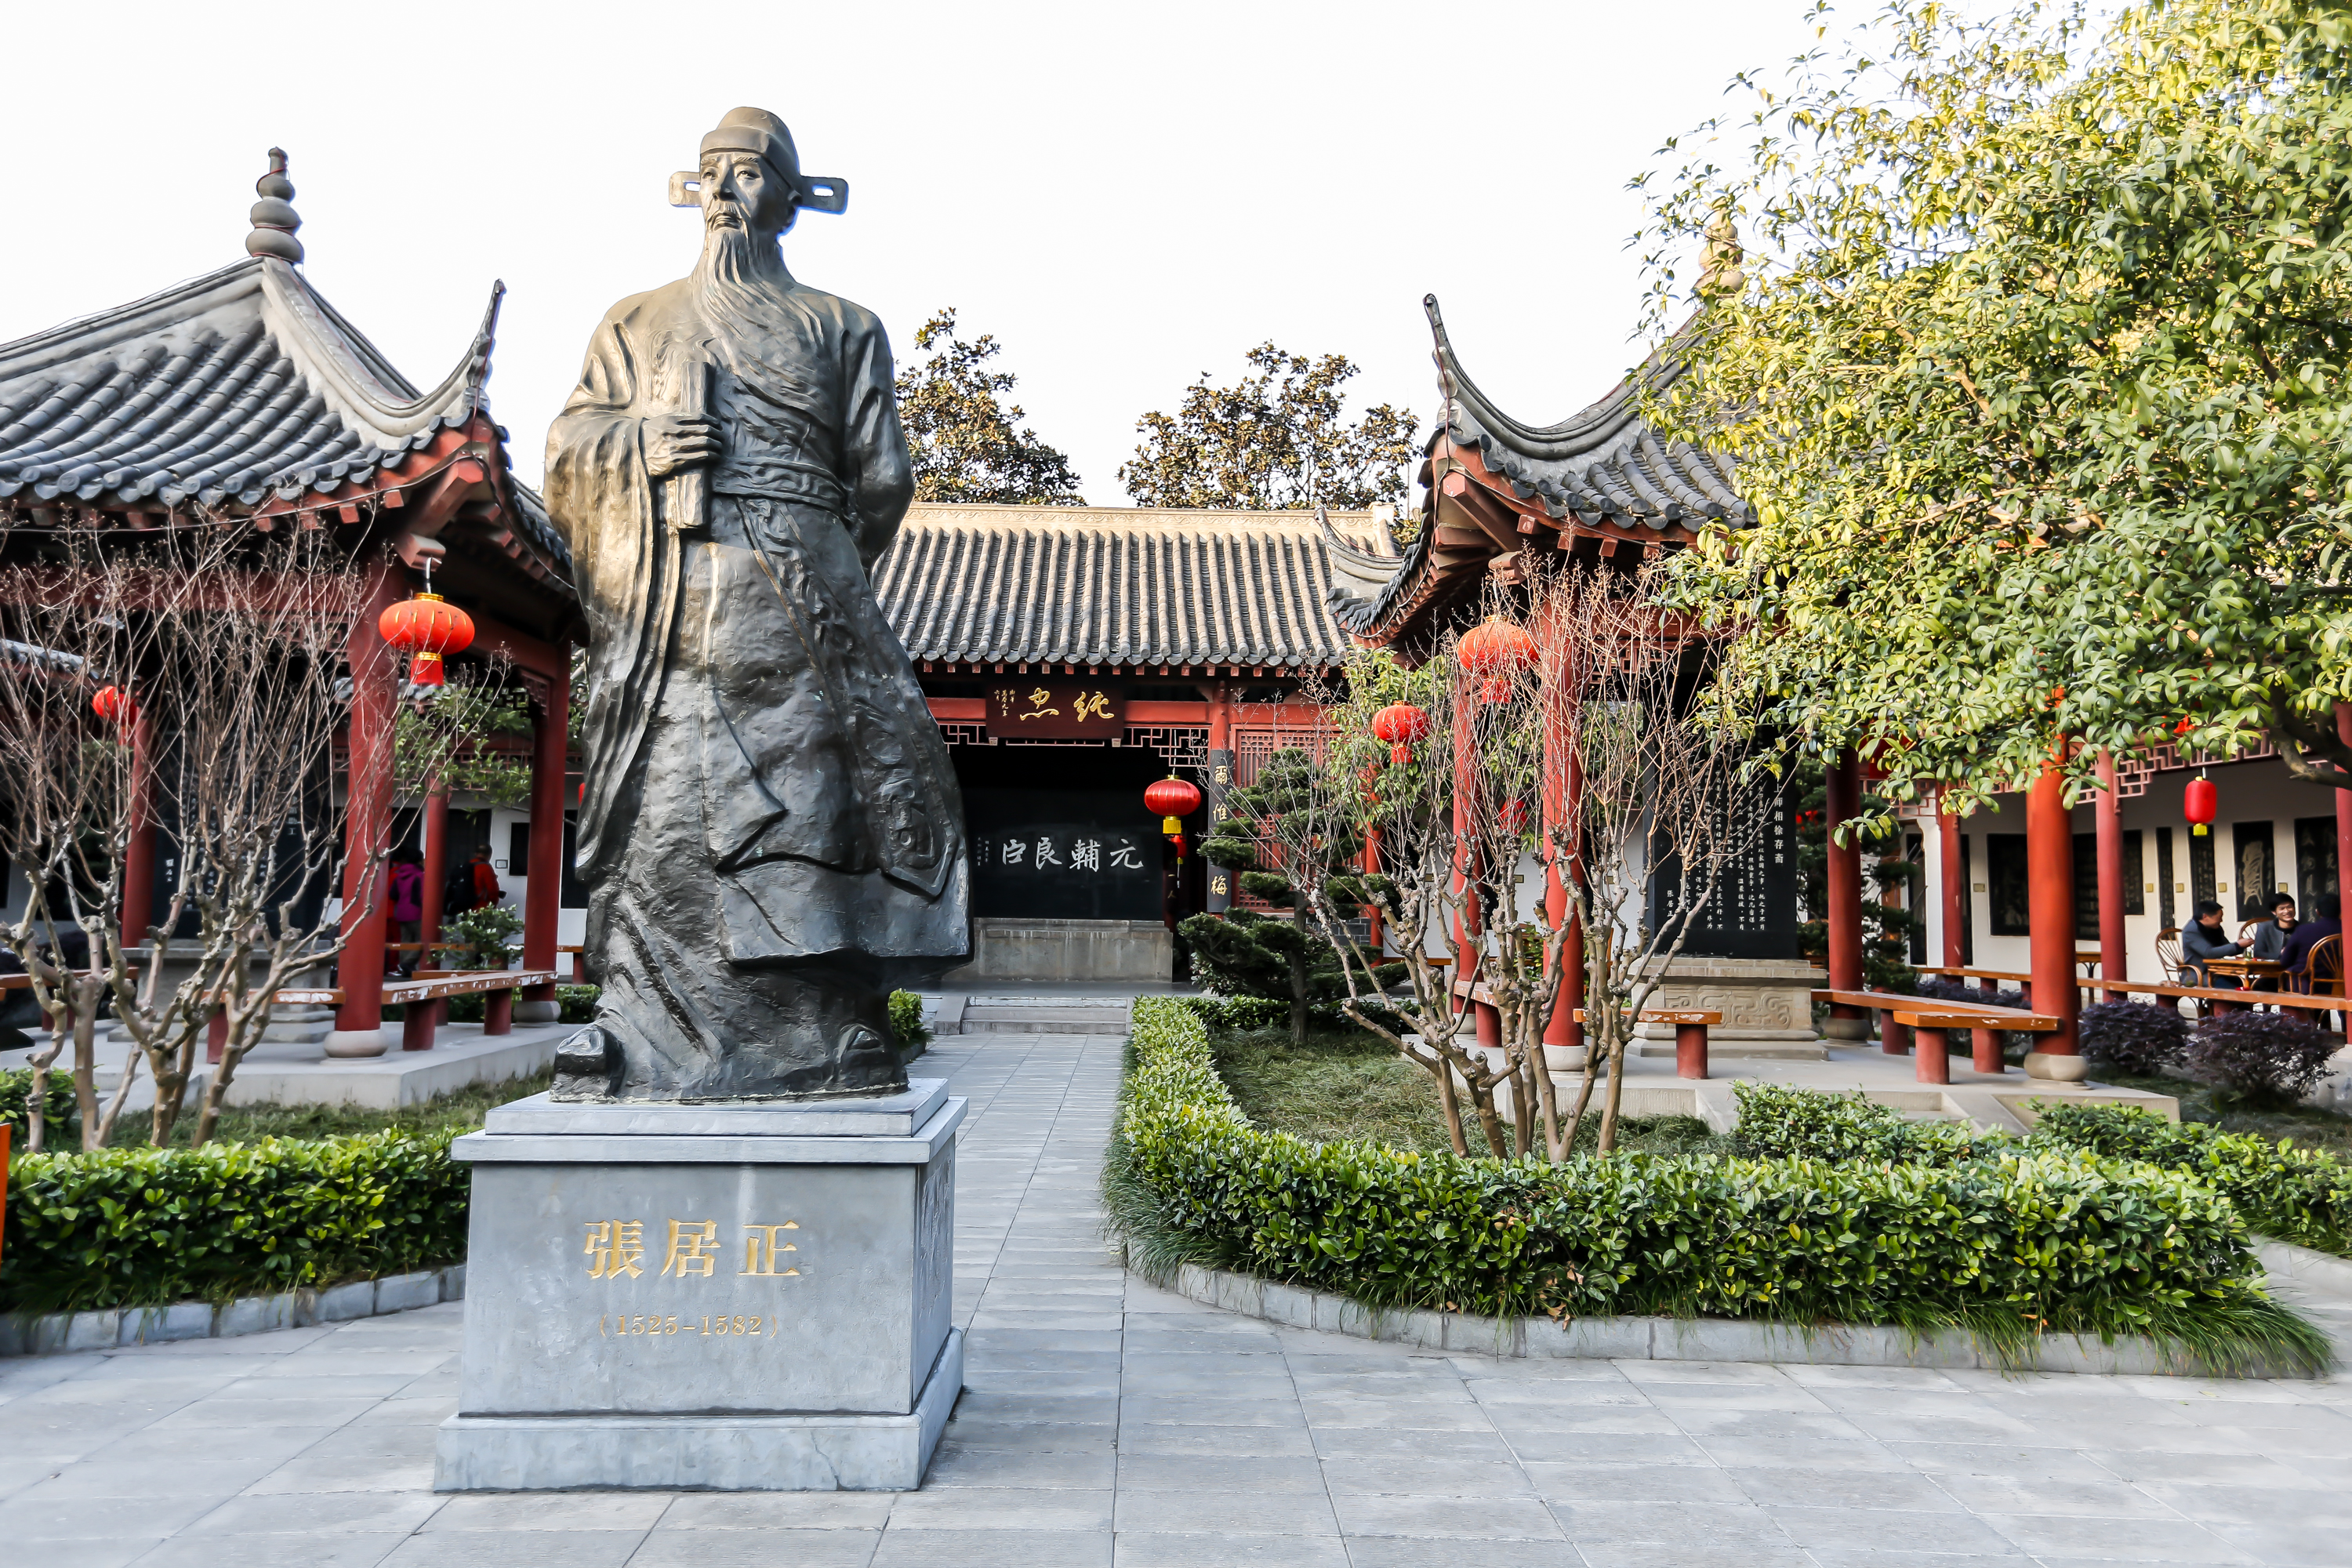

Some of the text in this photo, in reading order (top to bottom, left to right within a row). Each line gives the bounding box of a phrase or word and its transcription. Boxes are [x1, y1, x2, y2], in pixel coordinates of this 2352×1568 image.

[583, 1218, 800, 1279] 張居正
[600, 1313, 778, 1338] (1525-1582)
